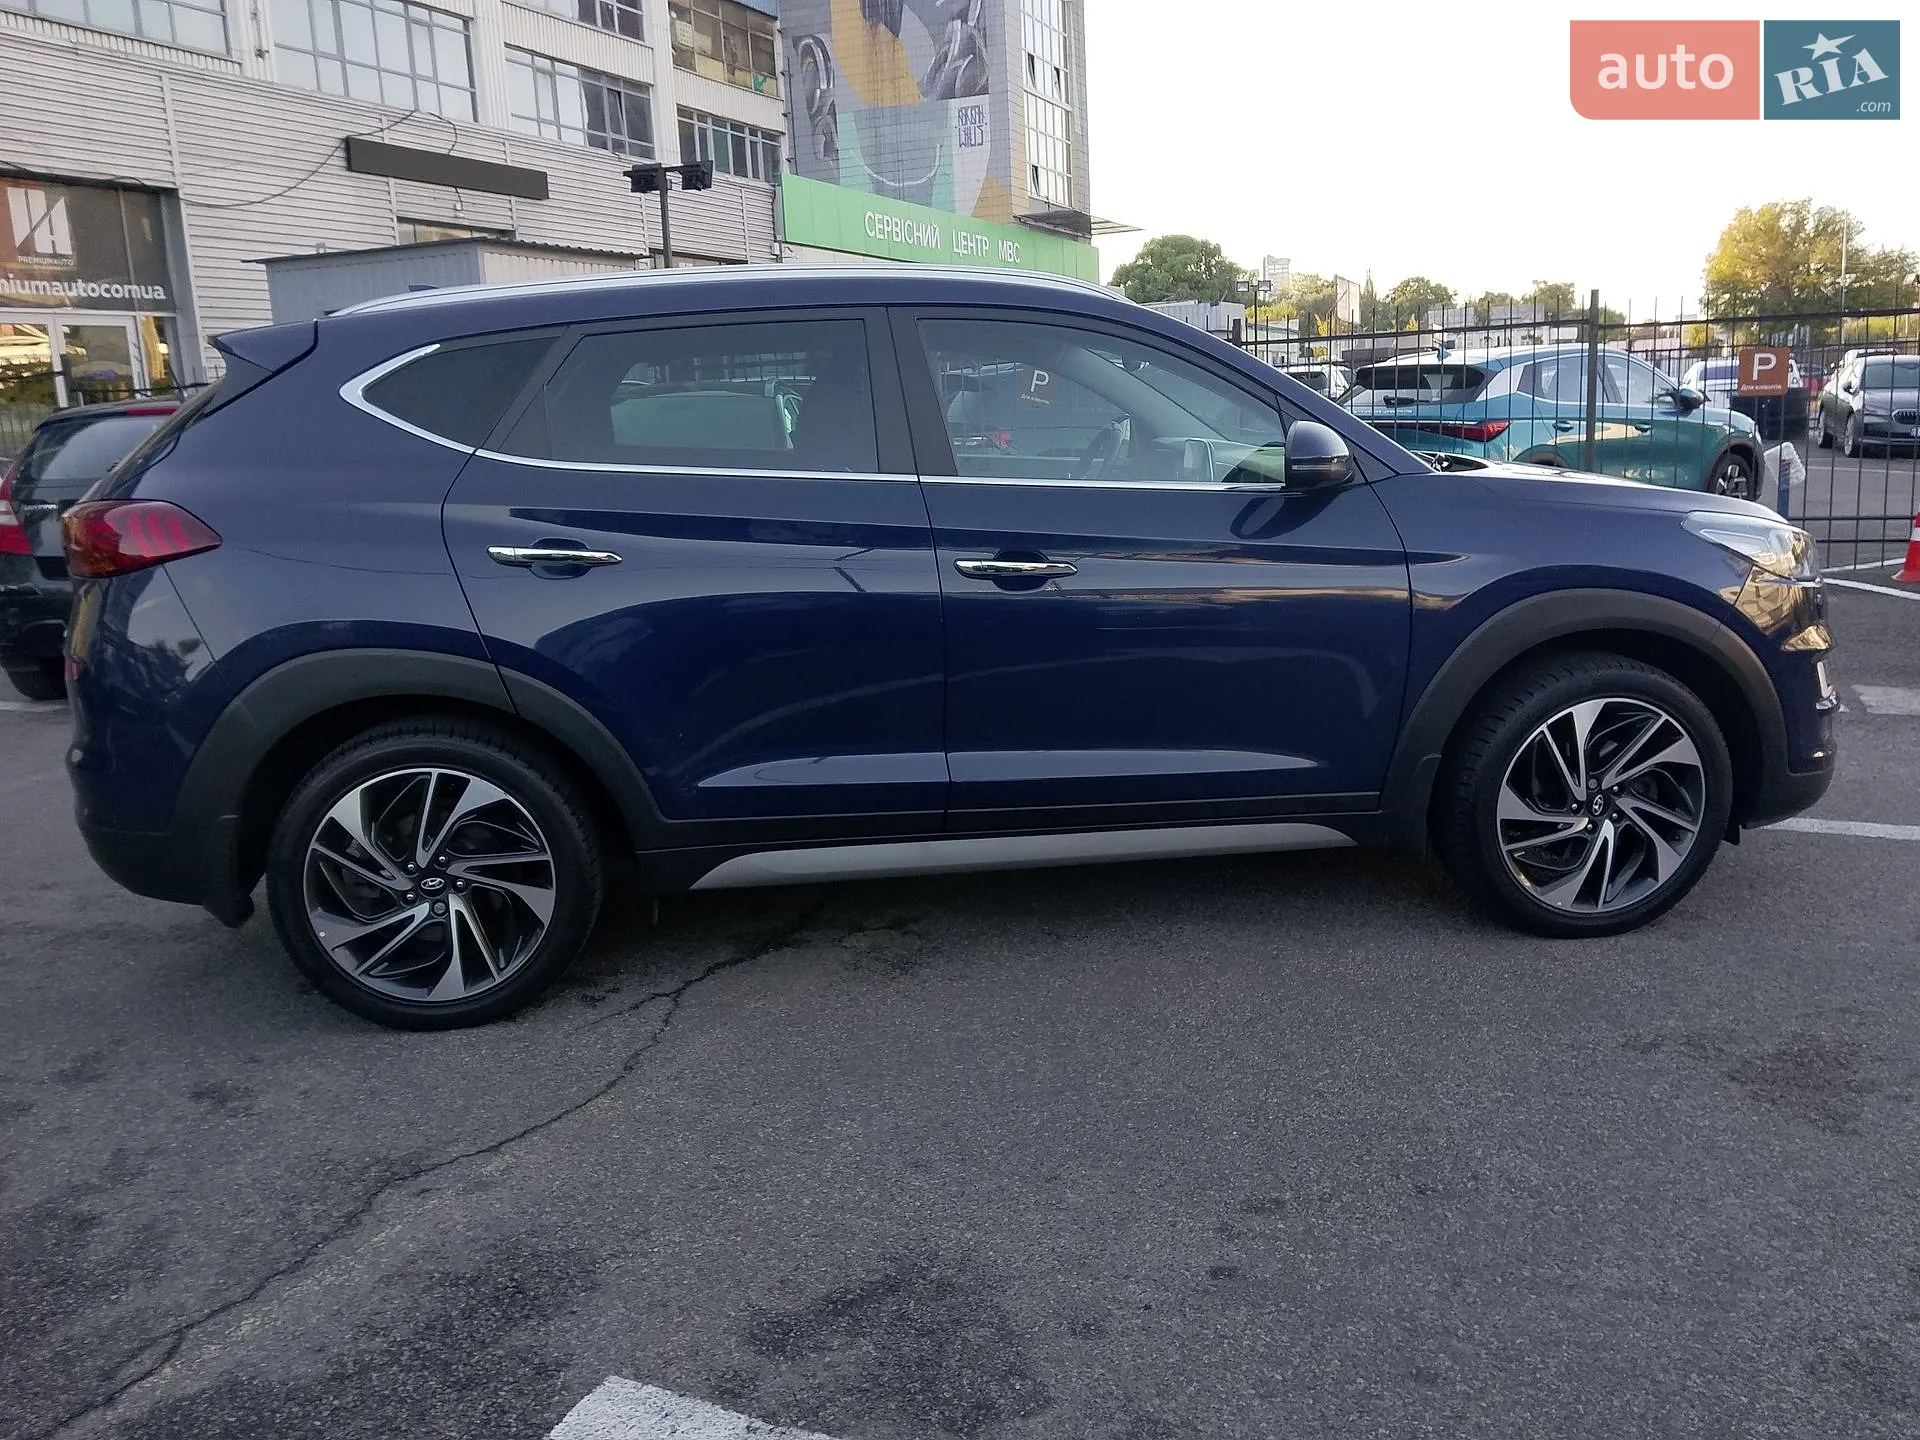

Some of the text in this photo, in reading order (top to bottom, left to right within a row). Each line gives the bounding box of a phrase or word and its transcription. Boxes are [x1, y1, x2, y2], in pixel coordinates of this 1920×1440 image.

[864, 211, 1021, 264] СЕРВІСНИЙ ЦЕНТР МВС
